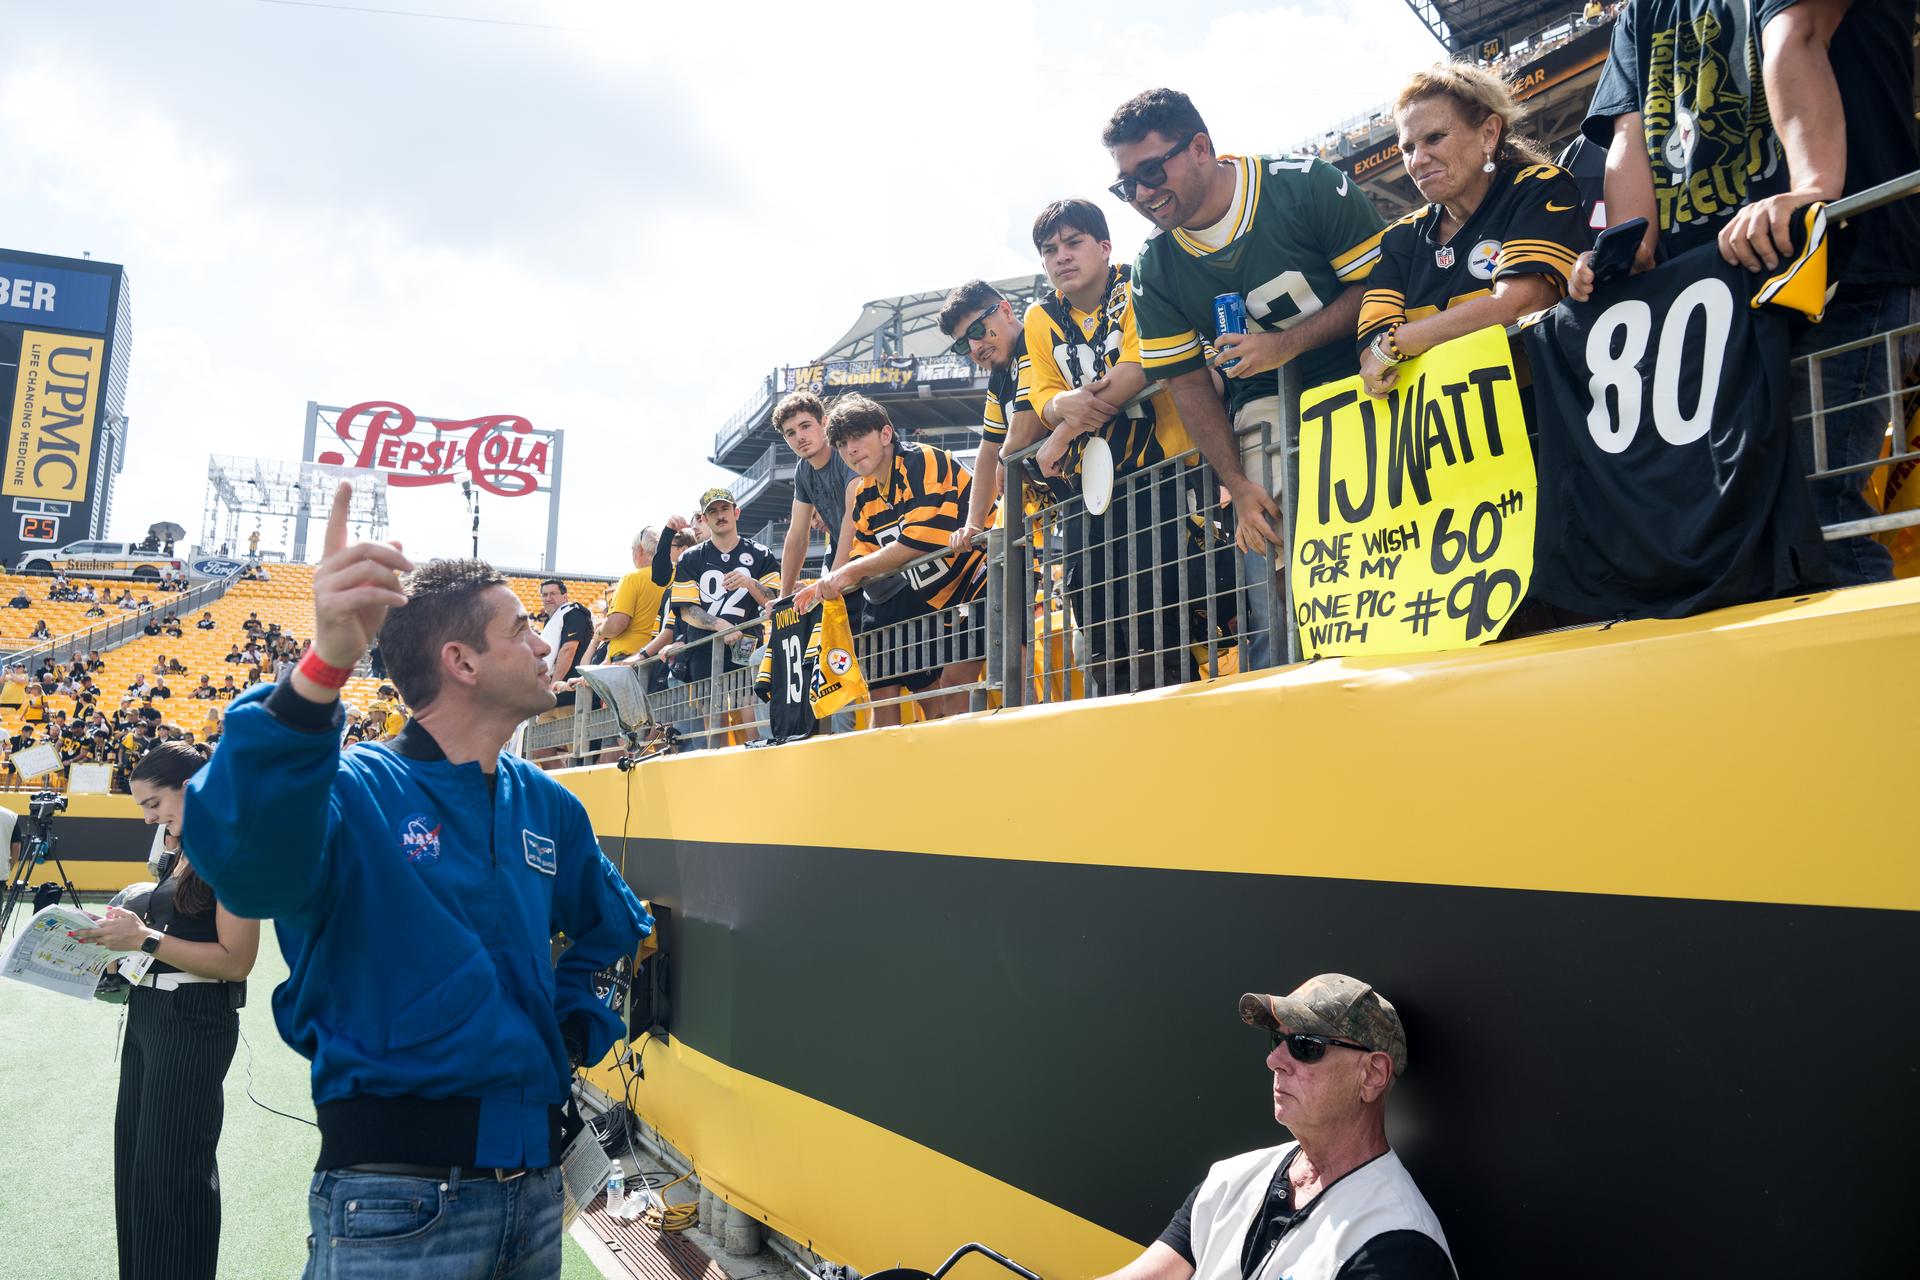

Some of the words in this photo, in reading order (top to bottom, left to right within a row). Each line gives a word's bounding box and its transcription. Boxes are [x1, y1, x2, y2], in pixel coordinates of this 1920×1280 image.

[1354, 143, 1401, 174] EXCLUS
[1217, 306, 1227, 333] LIGHT
[30, 344, 41, 368] LIFE
[795, 366, 824, 384] WE
[1585, 277, 1734, 454] 80
[22, 370, 37, 429] CHANGING
[33, 345, 93, 491] UPMC
[13, 431, 30, 487] MEDICINE
[1387, 365, 1512, 510] WATT
[24, 518, 55, 539] 25
[1300, 532, 1353, 567] ONE
[1362, 520, 1421, 556] WISH
[1309, 559, 1350, 588] FOR
[1359, 554, 1402, 580] MY
[1430, 489, 1524, 575] 60th
[66, 558, 115, 571] Steelers
[201, 560, 239, 576] Ford
[700, 566, 752, 618] 92
[1298, 593, 1352, 627] ONE
[1355, 589, 1396, 619] PIC
[1309, 622, 1369, 650] WITH
[1400, 568, 1522, 641] #90
[781, 634, 804, 704] 13
